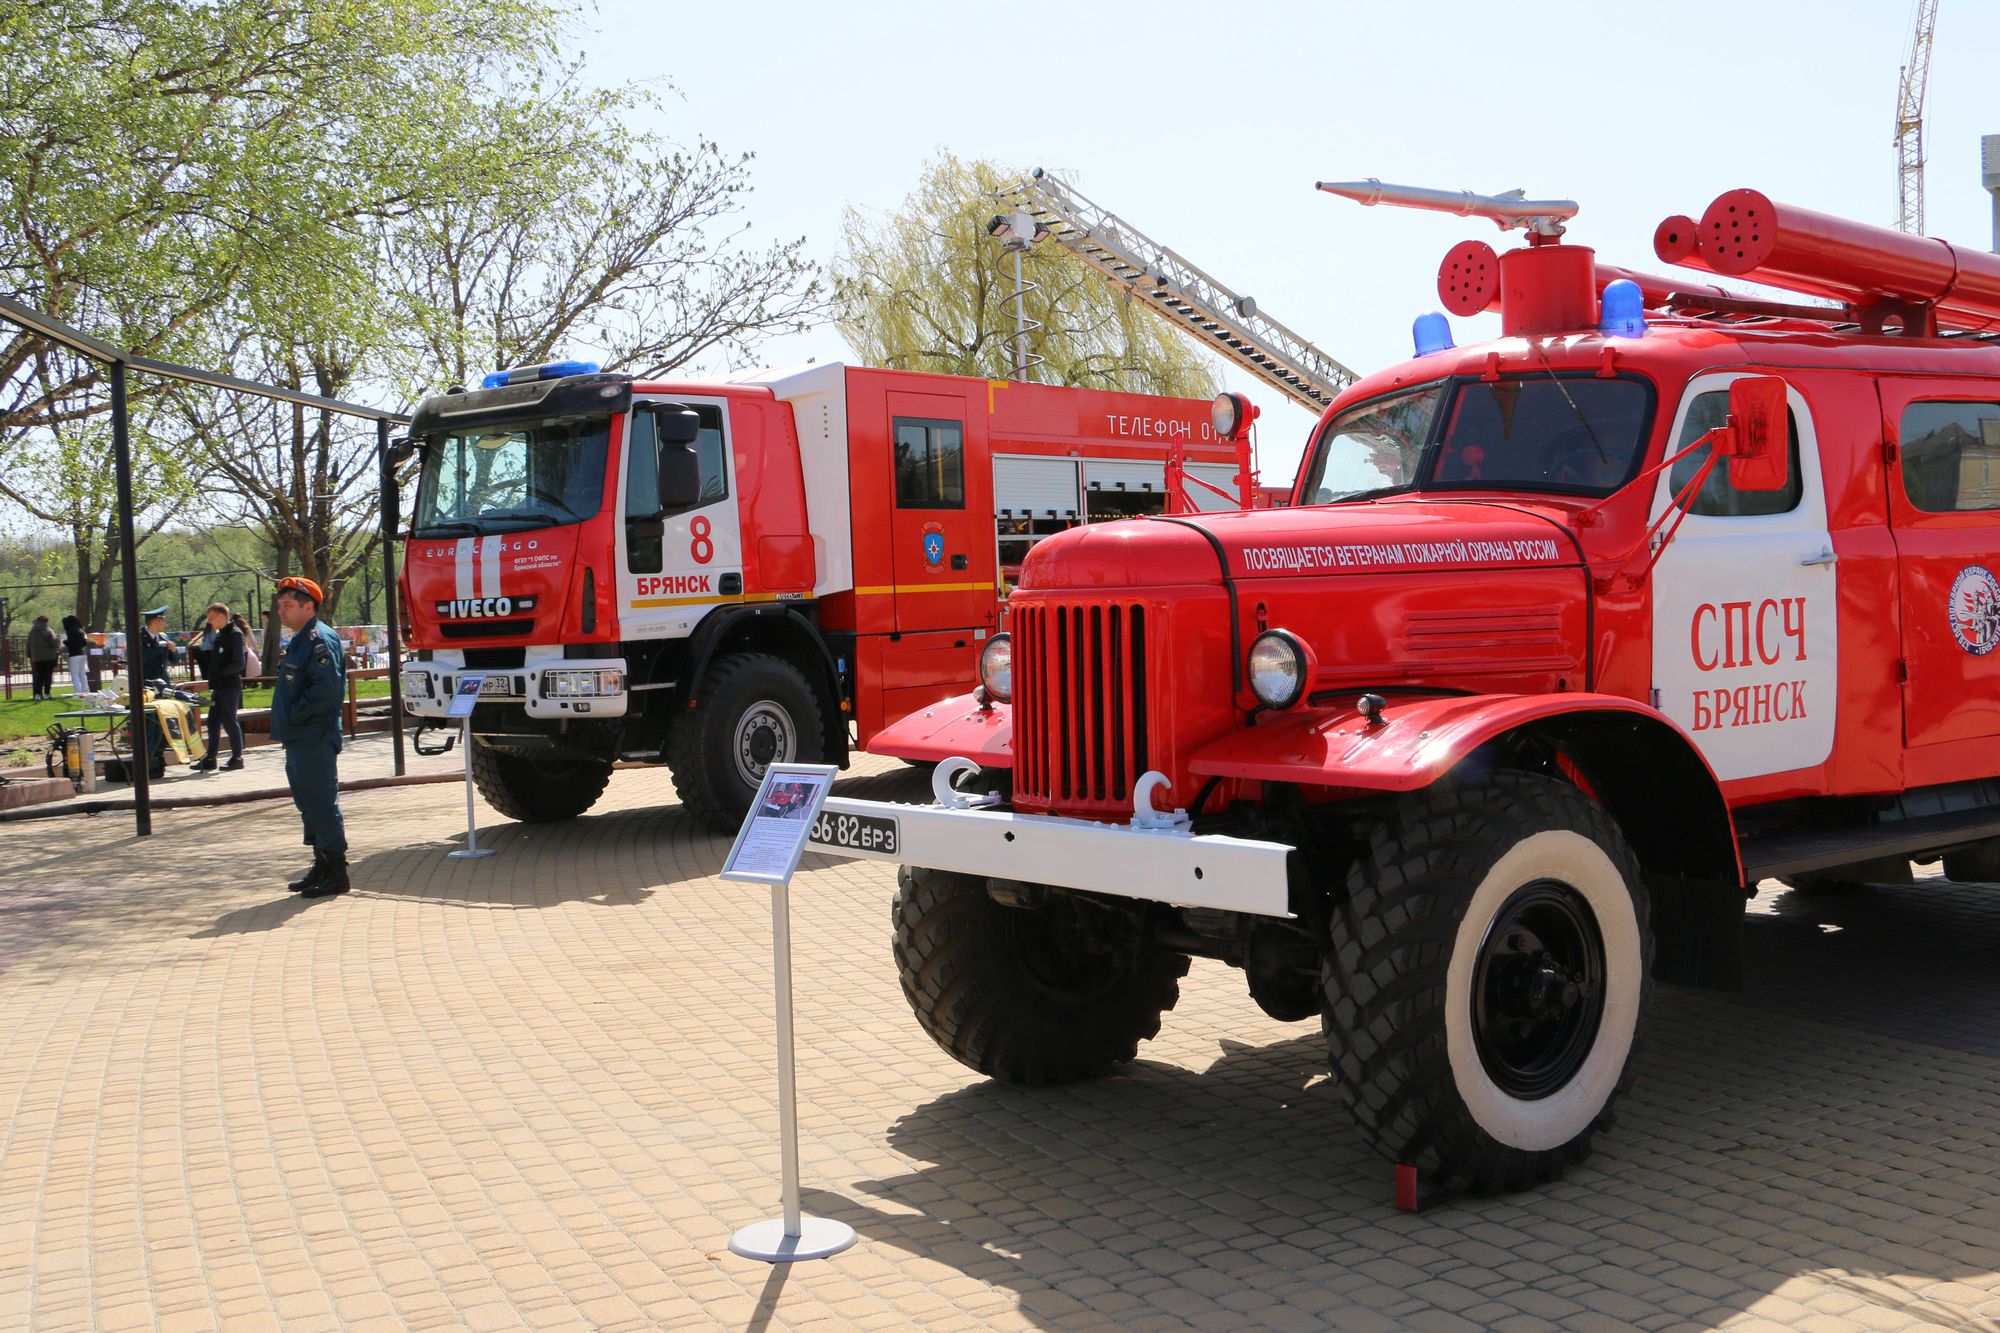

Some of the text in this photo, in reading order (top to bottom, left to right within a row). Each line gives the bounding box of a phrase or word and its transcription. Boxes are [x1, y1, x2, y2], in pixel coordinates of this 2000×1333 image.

[1107, 415, 1191, 439] ТЕЛЕФОН
[690, 515, 713, 564] 8
[1243, 538, 1559, 572] ПОСВЯЩАЕТСЯ ВЕТЕРАНАМ ПОЖАРНОЙ ОХРАНЫ РОССИИ
[637, 575, 711, 596] БРЯНСК
[450, 598, 511, 619] IVECO
[1691, 597, 1807, 671] СПСЧ
[1692, 680, 1807, 731] БРЯНСК
